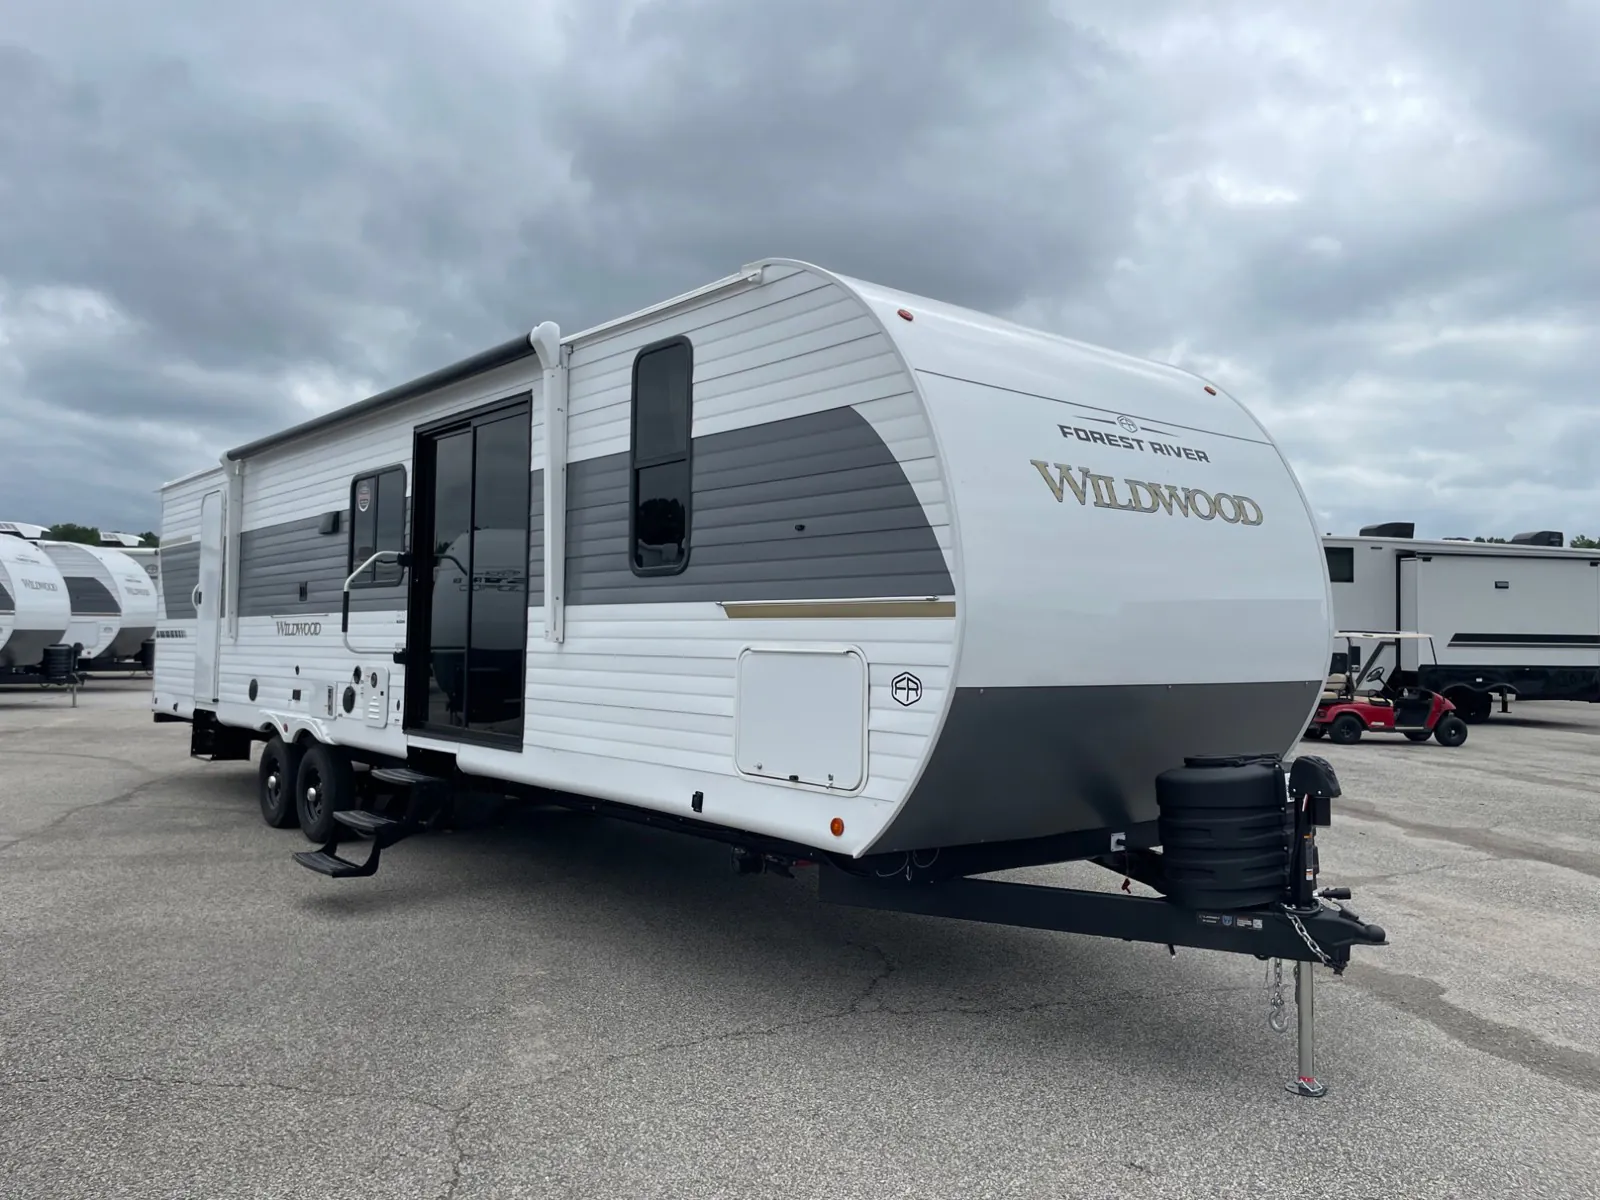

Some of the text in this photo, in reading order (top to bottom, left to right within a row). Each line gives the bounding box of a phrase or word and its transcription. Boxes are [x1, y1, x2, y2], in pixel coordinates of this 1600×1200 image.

[1057, 424, 1211, 463] FOREST RIVER
[1030, 459, 1264, 526] WILDWOOD
[276, 620, 322, 636] WILDWOOD
